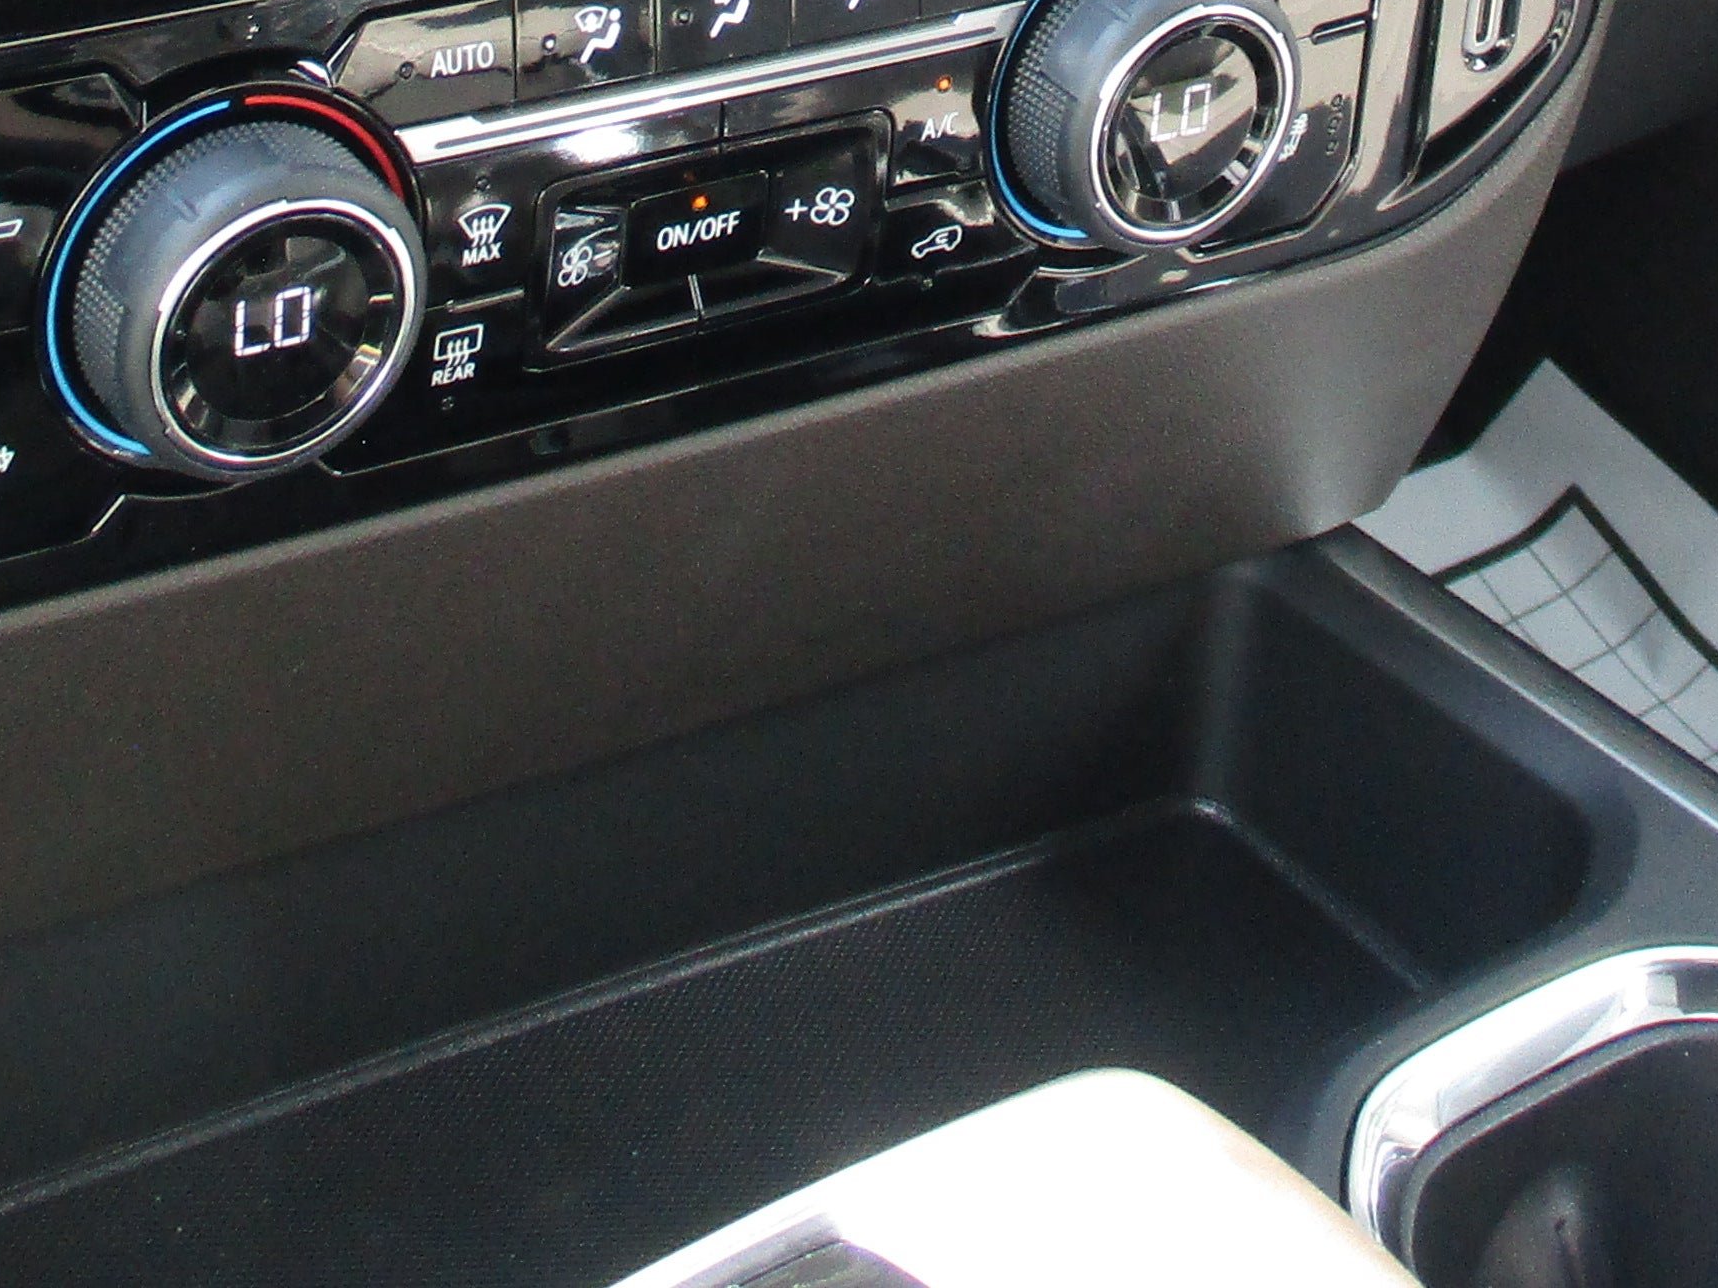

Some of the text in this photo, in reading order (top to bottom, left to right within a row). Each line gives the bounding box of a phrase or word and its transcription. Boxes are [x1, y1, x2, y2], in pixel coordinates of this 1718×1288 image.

[430, 41, 495, 79] AUTO
[920, 112, 959, 142] A/C
[1150, 83, 1212, 142] LO
[656, 210, 741, 252] ON/OFF
[462, 240, 502, 267] MAX
[234, 286, 312, 357] LO
[430, 362, 476, 387] REAR
